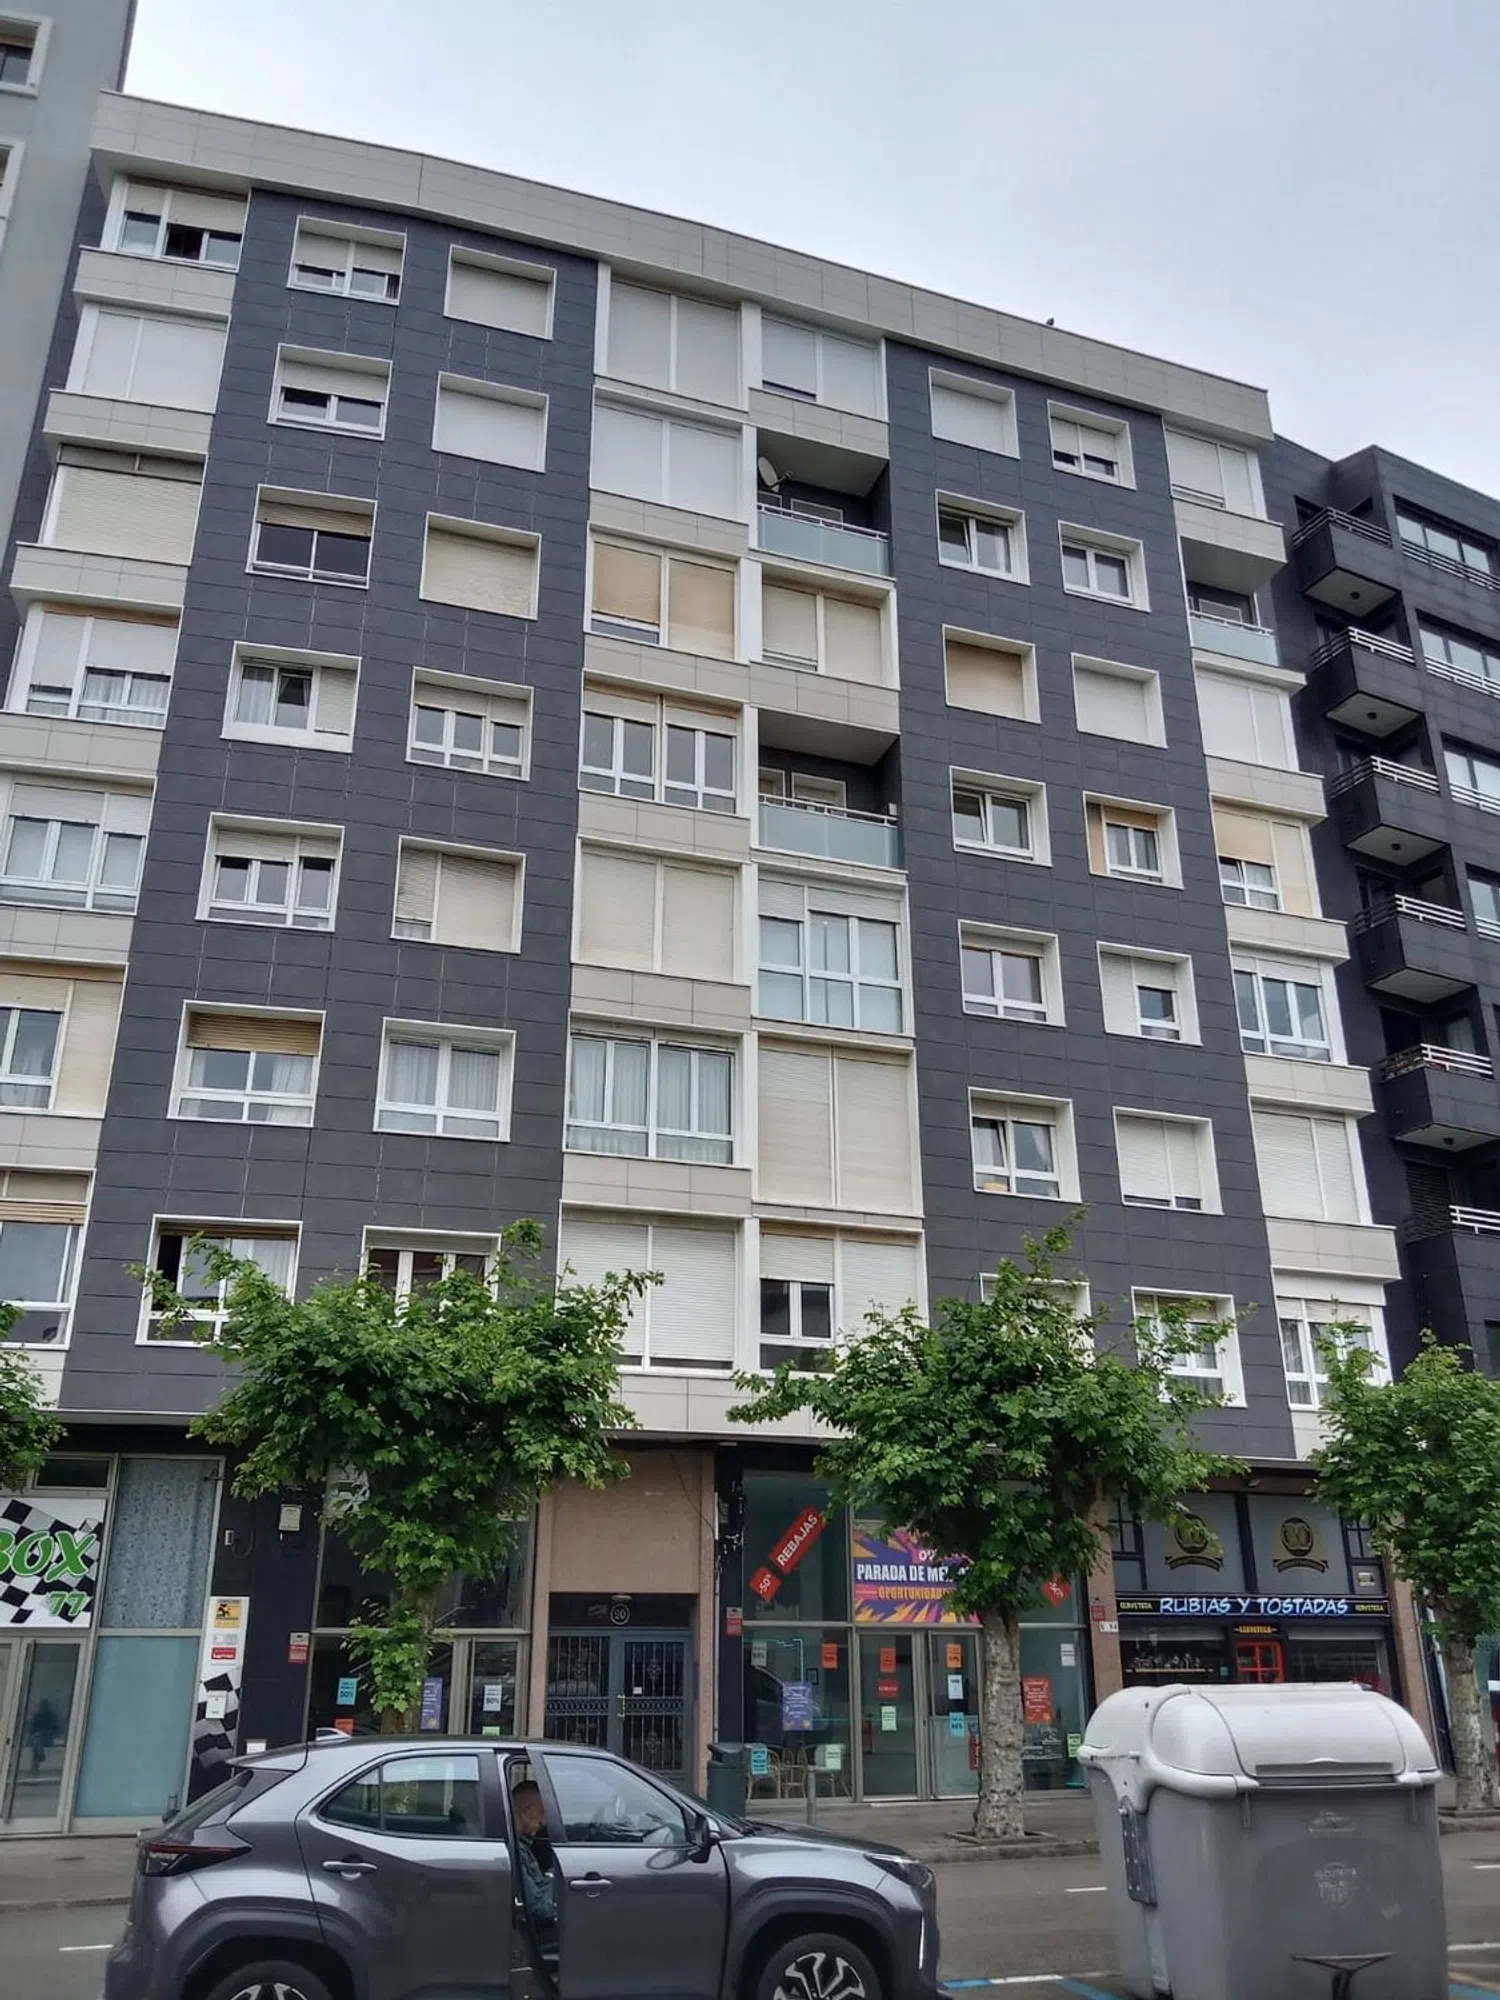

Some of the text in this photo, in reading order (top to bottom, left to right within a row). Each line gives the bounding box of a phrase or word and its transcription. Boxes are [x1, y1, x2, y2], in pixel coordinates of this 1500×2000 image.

[777, 1514, 818, 1566] REBAJAS
[856, 1564, 907, 1581] PARADA
[909, 1565, 925, 1581] DE
[48, 1591, 87, 1616] 77
[1160, 1597, 1348, 1616] RUBIAS Y TOSTADAS
